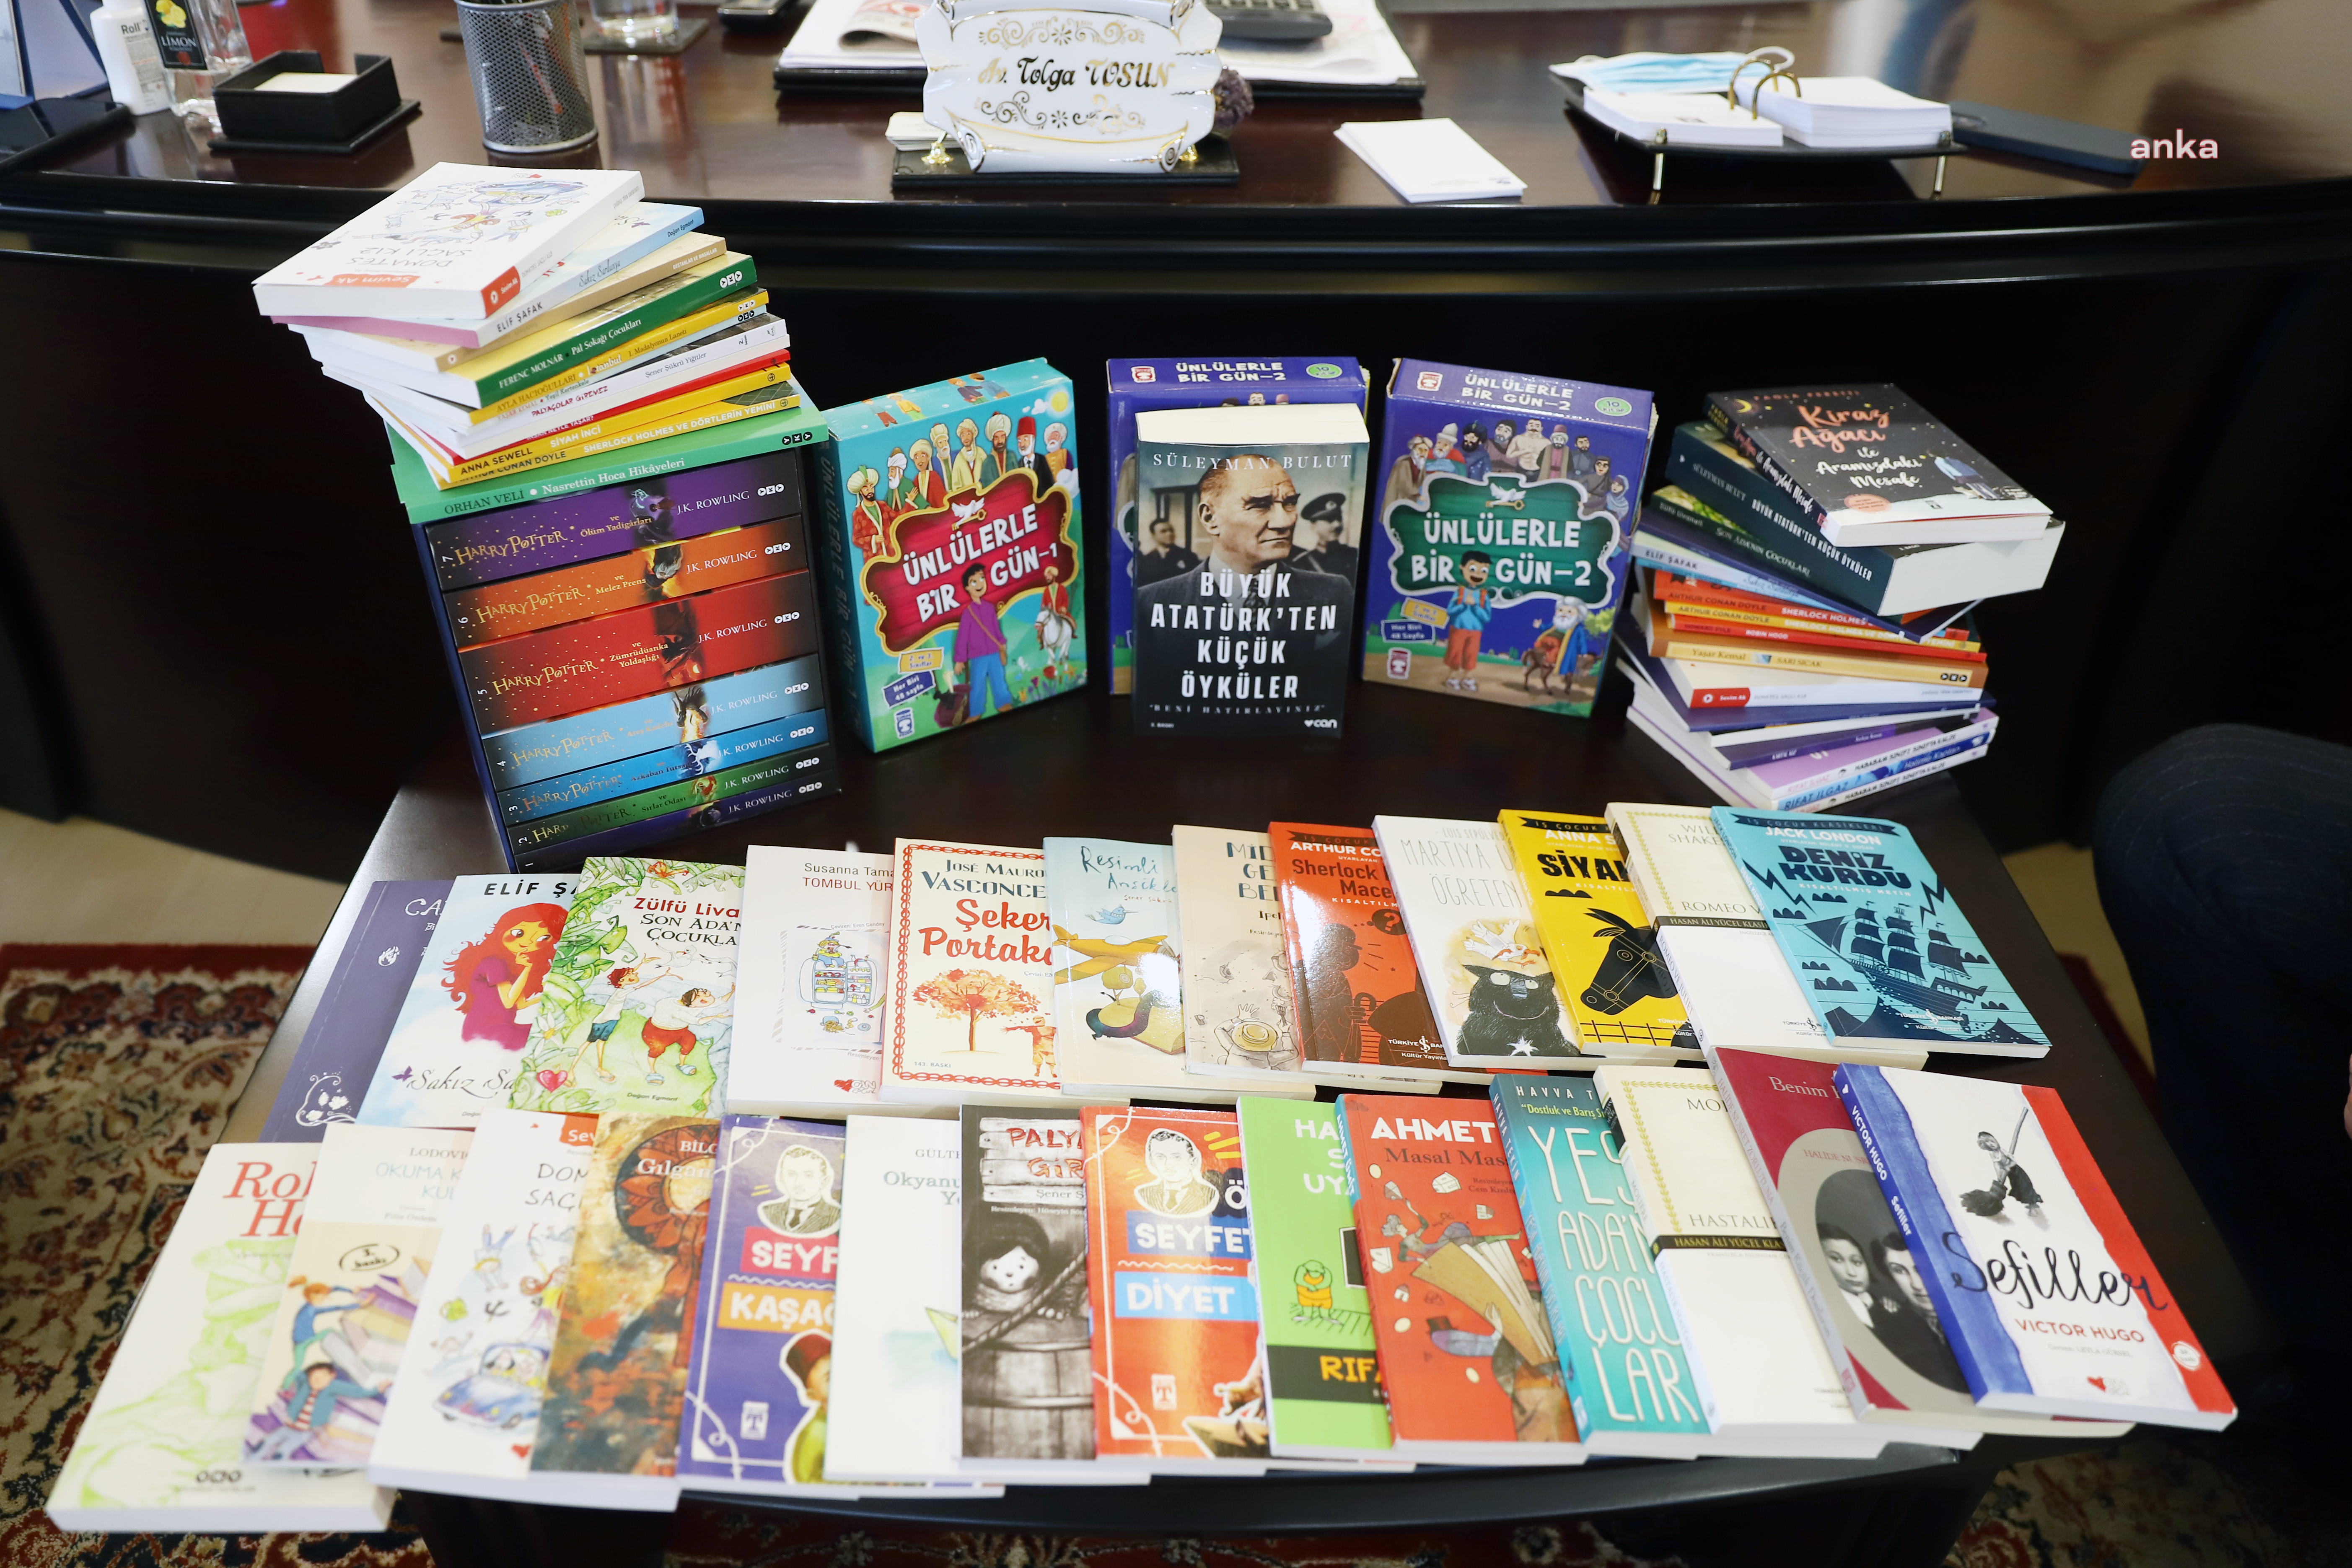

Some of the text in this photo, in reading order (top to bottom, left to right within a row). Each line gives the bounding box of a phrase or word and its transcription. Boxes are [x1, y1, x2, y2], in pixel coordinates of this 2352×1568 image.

[121, 23, 140, 34] Roll
[978, 56, 1176, 92] Av. Tolga TOSUN
[347, 258, 453, 267] DOMATES
[673, 257, 693, 269] DESTANLAR
[699, 248, 718, 260] MASALLAR
[497, 220, 694, 332] ELİF ŞAFAK Sakız Sardunya Doğan Egmont
[498, 319, 642, 389] FERENC MOLNÁR Pál Sokağı Çocukları
[634, 329, 687, 355] Madalyonun Laneti
[1176, 362, 1283, 373] ÜNLÜLERLE
[1178, 372, 1210, 382] BİR
[531, 352, 707, 417] PALYAÇOLAR GİREMEZ Şener Şükrü Yiğitler
[1462, 387, 1492, 401] BİR
[1465, 373, 1574, 399] ÜNLÜLERLE
[535, 402, 775, 463] DOYLE SHERLOCK HOLMES VE DÖRTLERİN YEMİNİ
[1789, 425, 1886, 453] Ağacı
[461, 425, 601, 475] ANNA SEWELL SİYAH İNCİ
[1153, 451, 1352, 471] SÜLEYMAN BULUT
[445, 458, 685, 514] ORHAN VELİ Nasrettin Hoca Hikâyeleri
[1849, 472, 1920, 489] Mesafe
[455, 490, 751, 565] HARRY POTTER J.K. ROWLING
[580, 517, 652, 538] Ölüm Yadigârları
[1423, 511, 1583, 548] ÜNLÜLERLE
[1752, 499, 1873, 581] BÜYÜK ATATÜRK'TEN KÜÇÜK ÖYKÜLER
[902, 503, 1038, 586] ÜNLÜLERLE
[1411, 549, 1456, 583] BİR
[1646, 550, 1698, 570] ELİF ŞAFAK
[475, 550, 757, 625] HARRY POTTER J.K. ROWLING
[595, 577, 647, 595] Melez Prens
[1200, 568, 1292, 598] BÜYÜK
[916, 583, 961, 622] BİR
[1668, 592, 1829, 620] ARTHUR CONAN DOYLE SHERLOCK
[1150, 603, 1337, 632] ATATÜRK'TEN
[1746, 629, 1766, 638] ROBIN
[492, 619, 768, 696] HARRY POTTER J.K. ROWLING
[609, 642, 669, 663] Zümrüdüanka
[619, 653, 660, 669] Yoldaşlığı
[1197, 636, 1287, 670] KÜÇÜK
[1181, 671, 1299, 699] ÖYKÜLER
[1313, 719, 1338, 728] can
[725, 766, 790, 790] J.K. ROWLING
[1290, 842, 1357, 855] ARTHUR
[1545, 829, 1600, 844] ANNA
[1765, 827, 1882, 845] JACK LONDON
[945, 859, 980, 874] JOSÉ
[1080, 845, 1159, 874] Resimli
[1400, 839, 1492, 871] MARTIYA
[1778, 845, 1894, 871] DENİZ
[804, 862, 860, 876] Susanna
[1292, 858, 1380, 881] Sherlock
[1778, 863, 1912, 889] KURDU
[484, 879, 540, 895] ELİF
[802, 877, 862, 891] TOMBUL
[1429, 873, 1523, 909] ÖĞRETEN
[633, 897, 687, 915] Zülfü
[1682, 901, 1747, 914] ROMEO
[640, 913, 682, 927] SON
[1670, 917, 1697, 926] HASAN
[1713, 917, 1741, 927] YÜCEL
[406, 1065, 479, 1098] Sakız
[1516, 1085, 1574, 1099] HAVVA
[1767, 1076, 1827, 1098] Benim
[651, 1093, 678, 1101] Egmont
[1561, 1106, 1572, 1116] ve
[1572, 1106, 1597, 1120] Barış
[1370, 1117, 1496, 1144] AHMET
[1384, 1146, 1451, 1166] Masal
[375, 1162, 445, 1181] OKUMA
[1851, 1104, 1912, 1237] VICTOR HUGO Sefiller
[1036, 1189, 1079, 1200] Şener
[1940, 1231, 2169, 1311] Sefiller
[1126, 1278, 1236, 1315] DİYET
[2013, 1317, 2146, 1344] VICTOR HUGO
[1591, 1346, 1700, 1423] LAR
